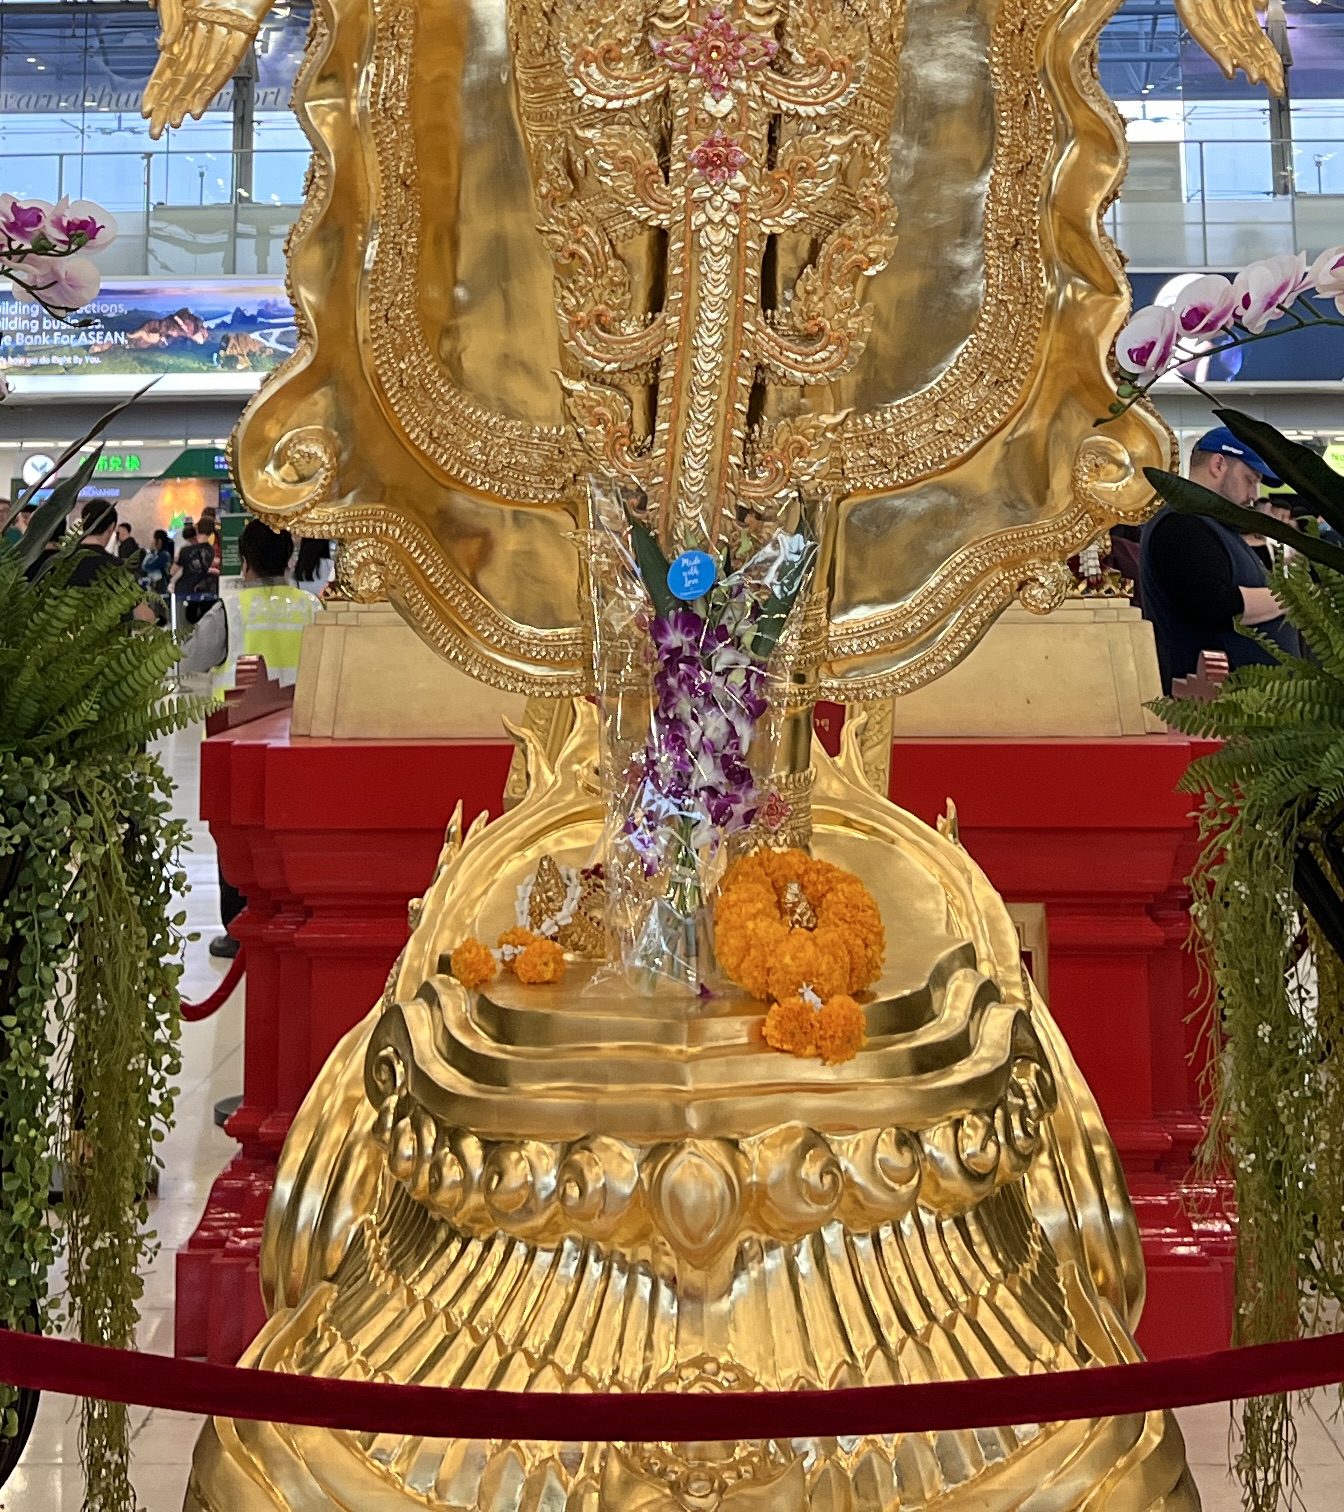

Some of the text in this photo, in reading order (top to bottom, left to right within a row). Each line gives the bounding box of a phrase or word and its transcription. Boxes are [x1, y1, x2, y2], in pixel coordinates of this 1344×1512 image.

[16, 332, 50, 346] Bank
[53, 331, 74, 345] For
[78, 331, 129, 345] ASEAN.
